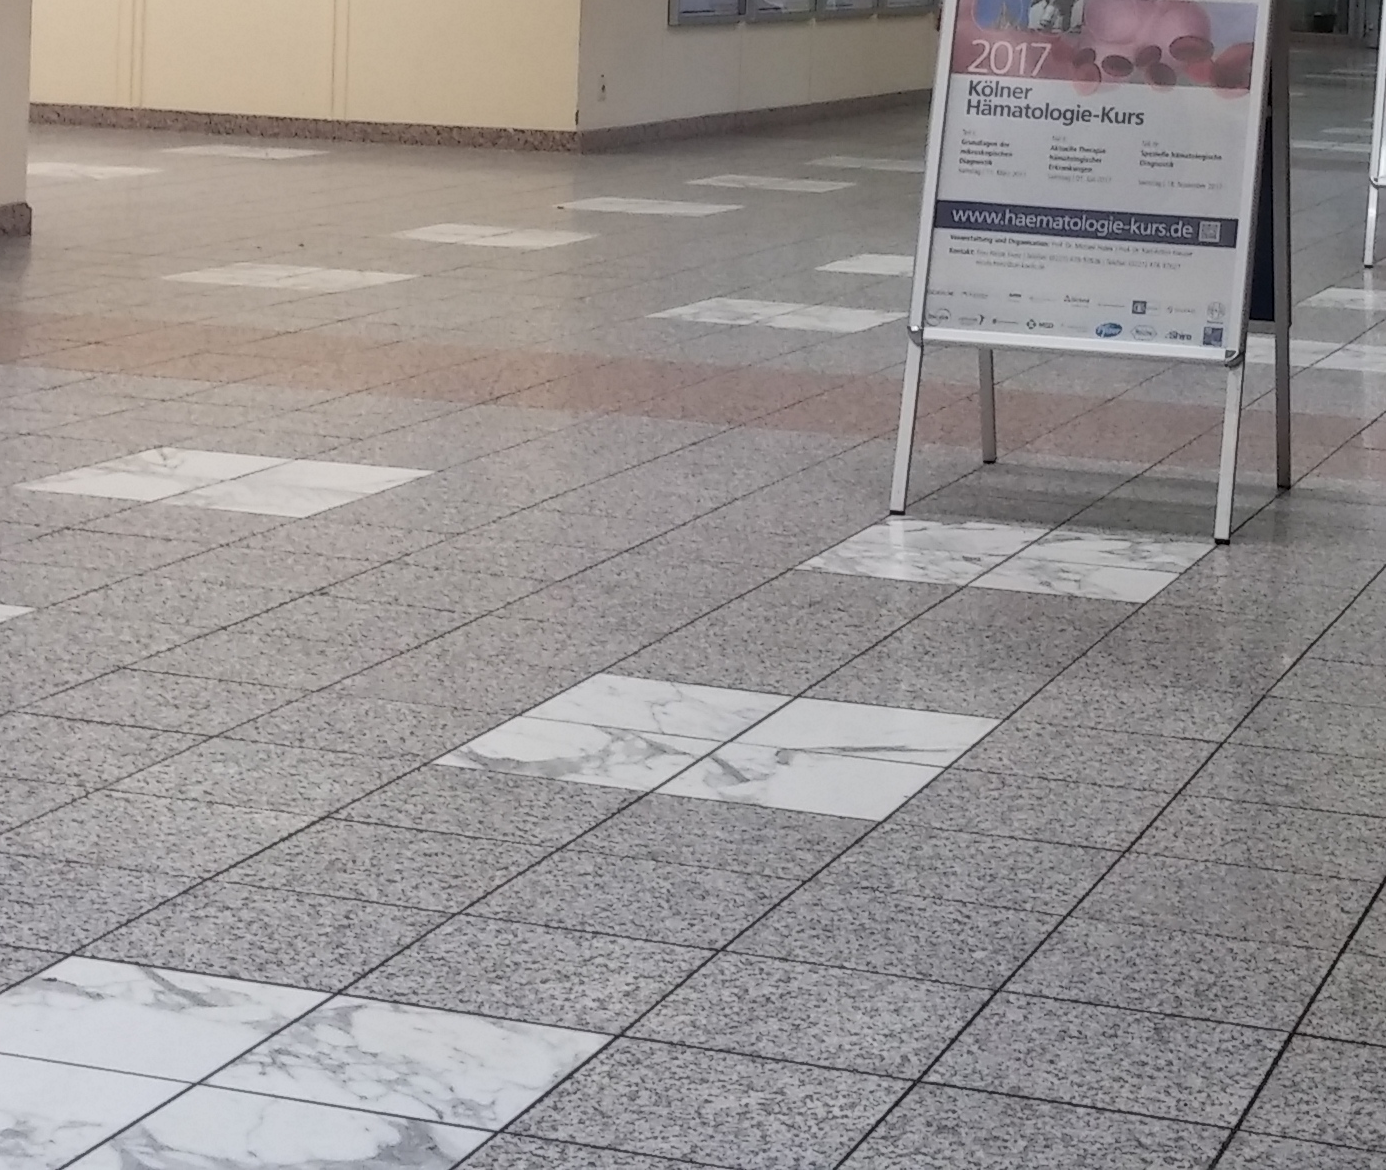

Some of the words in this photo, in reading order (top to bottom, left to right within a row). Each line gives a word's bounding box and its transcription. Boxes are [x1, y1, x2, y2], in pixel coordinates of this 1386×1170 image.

[967, 38, 1053, 76] 2017
[967, 80, 1033, 100] Kölner
[965, 98, 1145, 126] Hämatologie-Kurs
[951, 208, 1194, 238] www.haematologie-kurs.de
